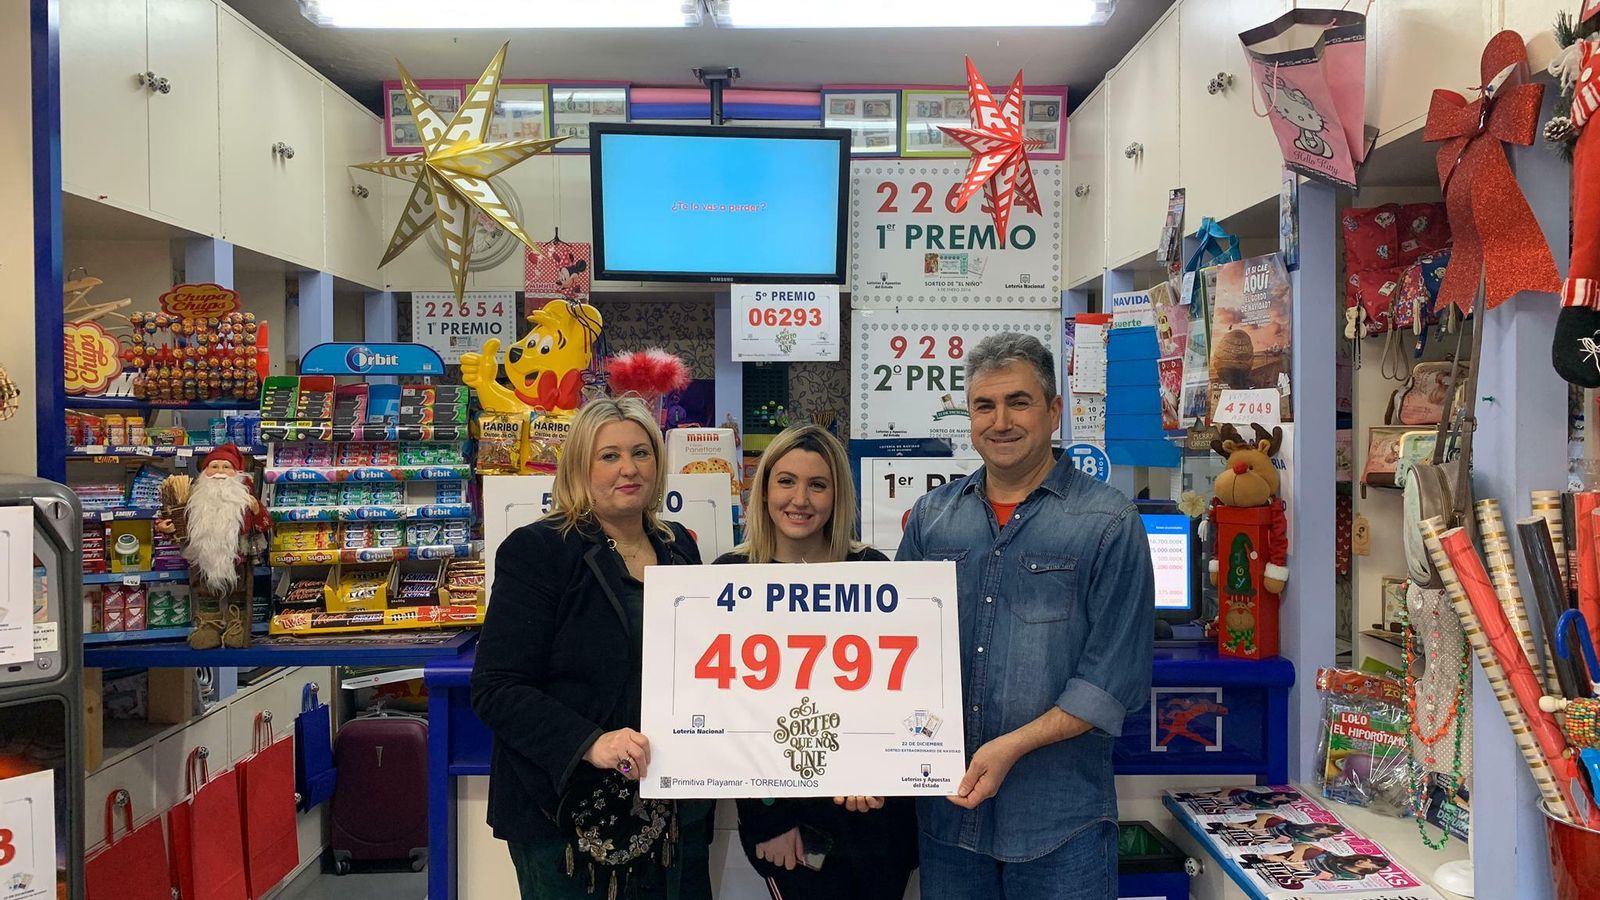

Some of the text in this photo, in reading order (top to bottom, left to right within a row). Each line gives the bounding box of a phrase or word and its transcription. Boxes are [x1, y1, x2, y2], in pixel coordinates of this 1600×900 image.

[1243, 270, 1269, 294] AQUÍ
[174, 293, 227, 303] Chupa
[771, 291, 816, 301] PREMIO
[172, 301, 226, 314] Chups
[425, 302, 504, 318] 22654
[748, 307, 822, 327] 06293
[441, 322, 502, 335] PREMIO
[80, 334, 104, 383] Chups
[345, 346, 399, 373] Orbit
[1225, 402, 1272, 414] 47049
[483, 422, 518, 432] HARIBO
[285, 469, 316, 481] Orbit
[354, 467, 385, 480] Orbit
[421, 468, 451, 479] Orbit
[357, 506, 387, 519] Orbit
[421, 505, 451, 518] Orbit
[766, 583, 899, 613] PREMIO
[694, 633, 919, 691] 49797
[789, 696, 819, 719] EL
[1342, 713, 1367, 725] LOLO
[773, 712, 840, 744] SORTEO
[1333, 724, 1345, 735] EL
[790, 731, 840, 751] QUE NOS
[784, 749, 828, 780] UNE
[672, 778, 705, 786] Primitiva
[707, 778, 743, 788] Playamar
[750, 778, 819, 788] TORREMOLINOS
